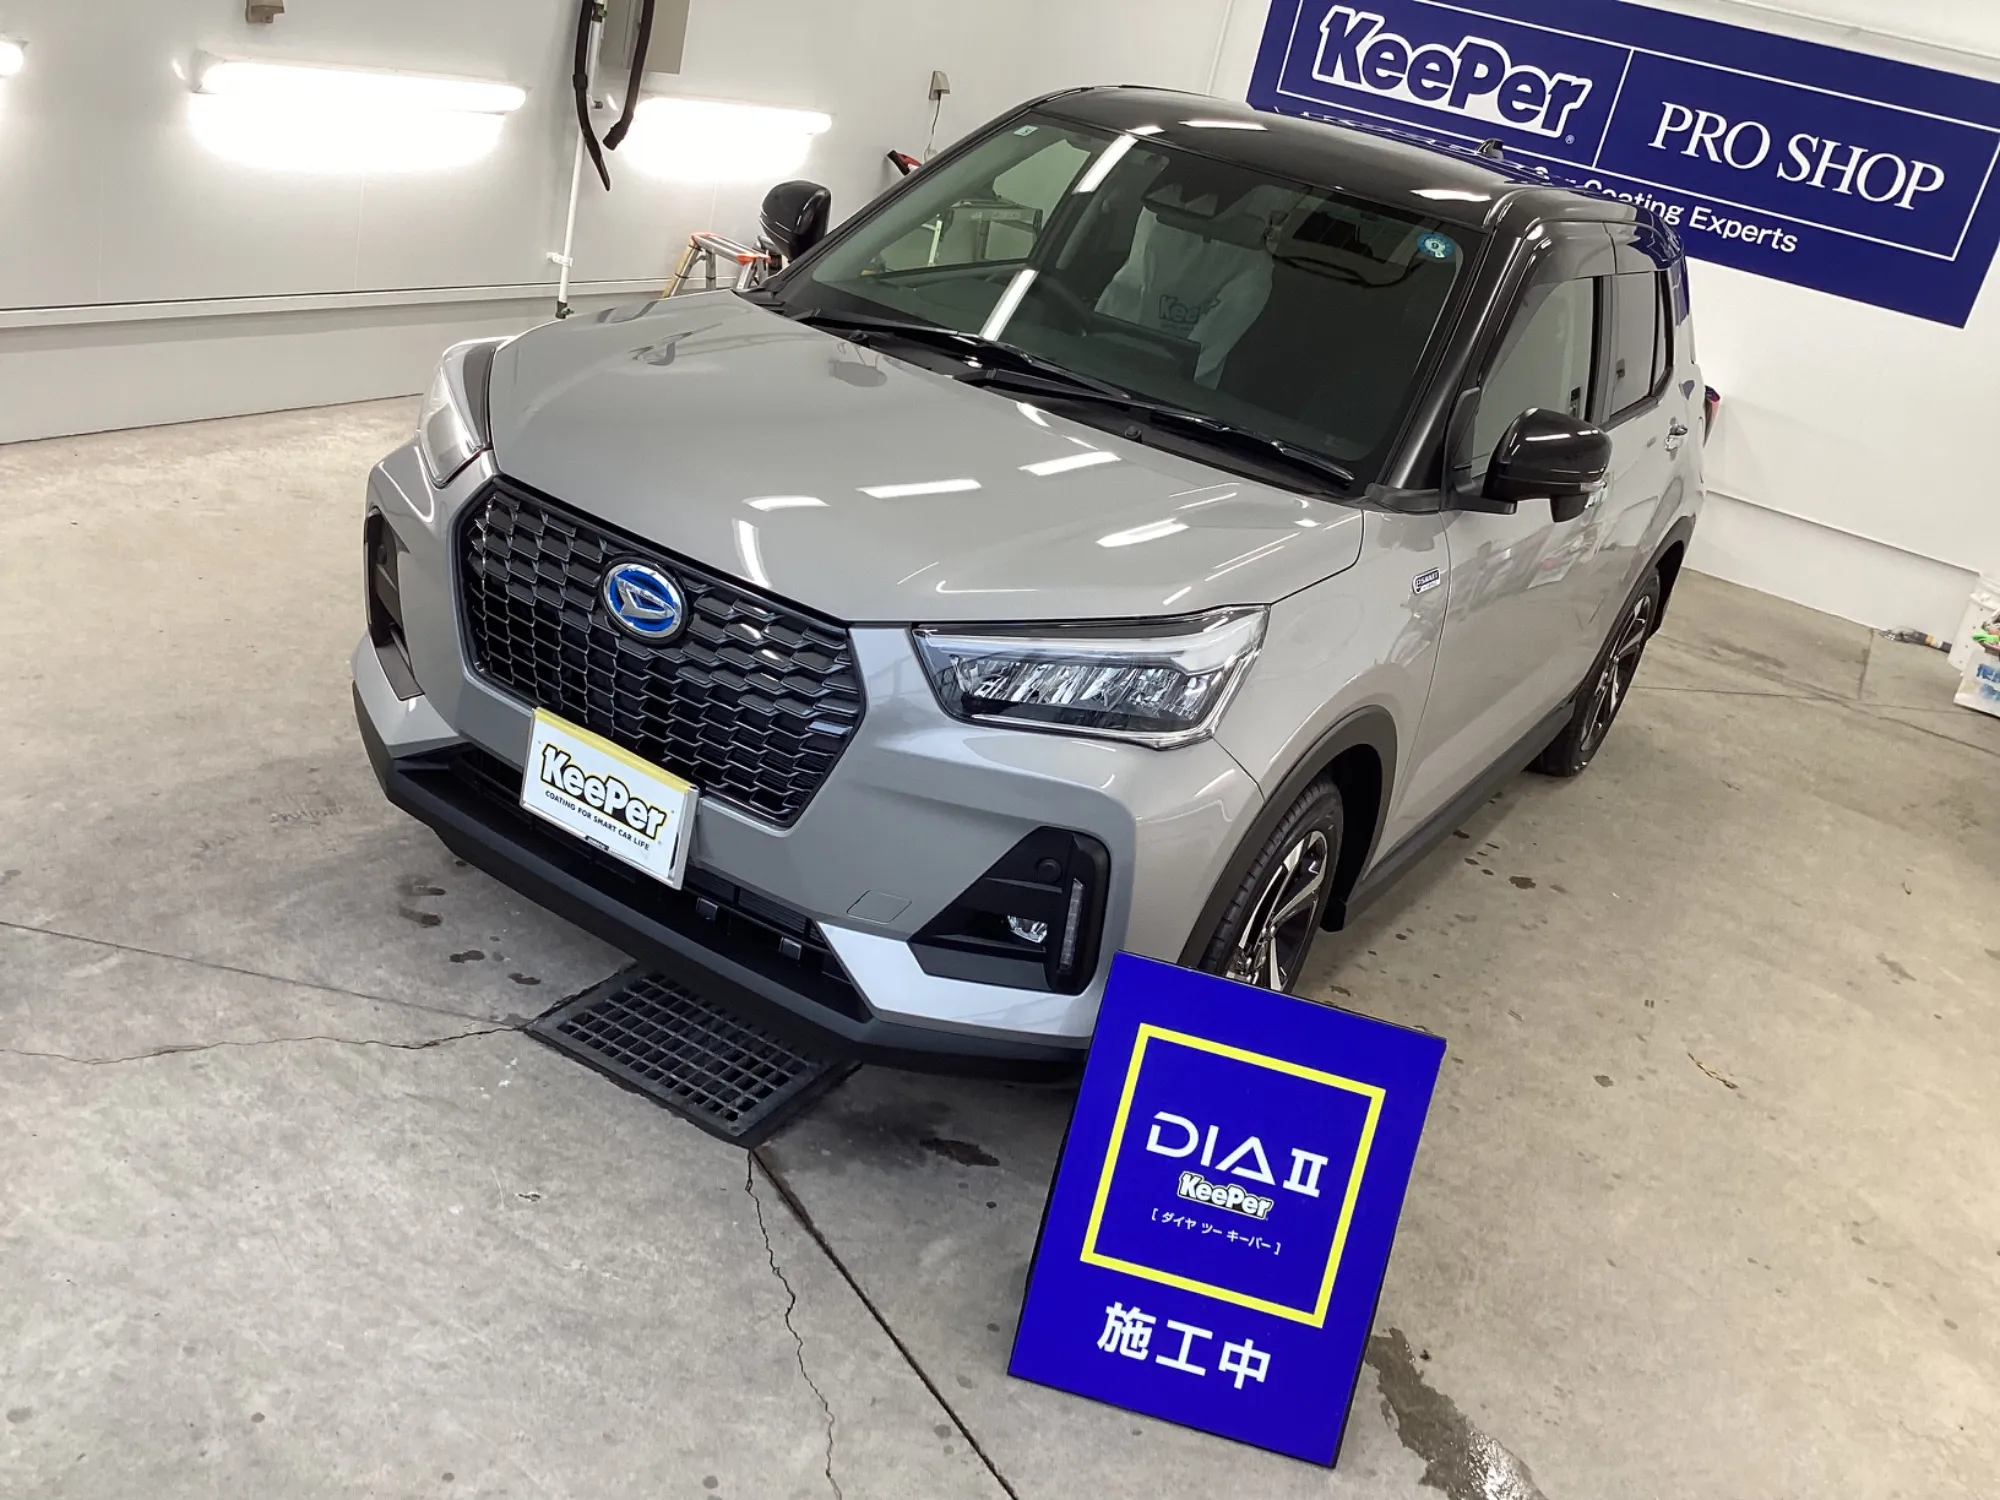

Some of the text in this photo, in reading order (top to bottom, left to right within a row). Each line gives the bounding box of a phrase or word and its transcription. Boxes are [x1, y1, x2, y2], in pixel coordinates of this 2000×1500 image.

[1311, 5, 1592, 138] KeePer
[1648, 101, 1945, 210] PRO SHOP
[1688, 205, 1798, 253] Experts
[541, 743, 667, 841] KeePer
[545, 790, 650, 851] COATING FOR SMART CAR LIFE
[1146, 1111, 1276, 1185] DIA
[1177, 1171, 1274, 1220] KeePer
[1096, 1301, 1271, 1390] 施工中
